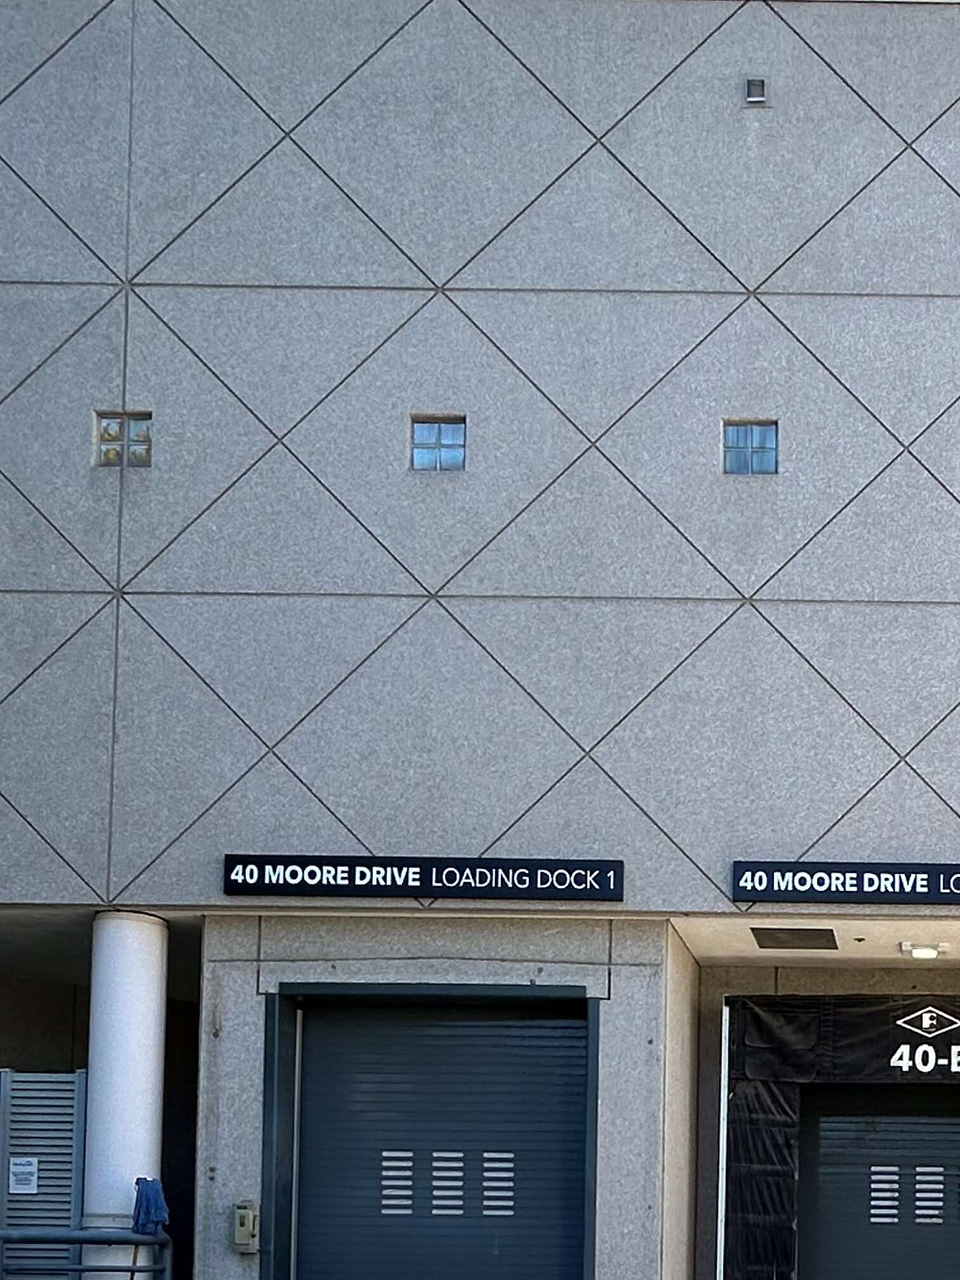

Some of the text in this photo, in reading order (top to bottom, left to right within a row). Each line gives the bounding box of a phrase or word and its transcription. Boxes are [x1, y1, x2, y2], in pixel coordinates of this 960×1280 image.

[231, 865, 615, 889] 40 MOORE DRIVE LOADING DOCK 1
[739, 871, 767, 890] 40
[774, 872, 857, 891] MOORE
[863, 873, 928, 892] DRIVE
